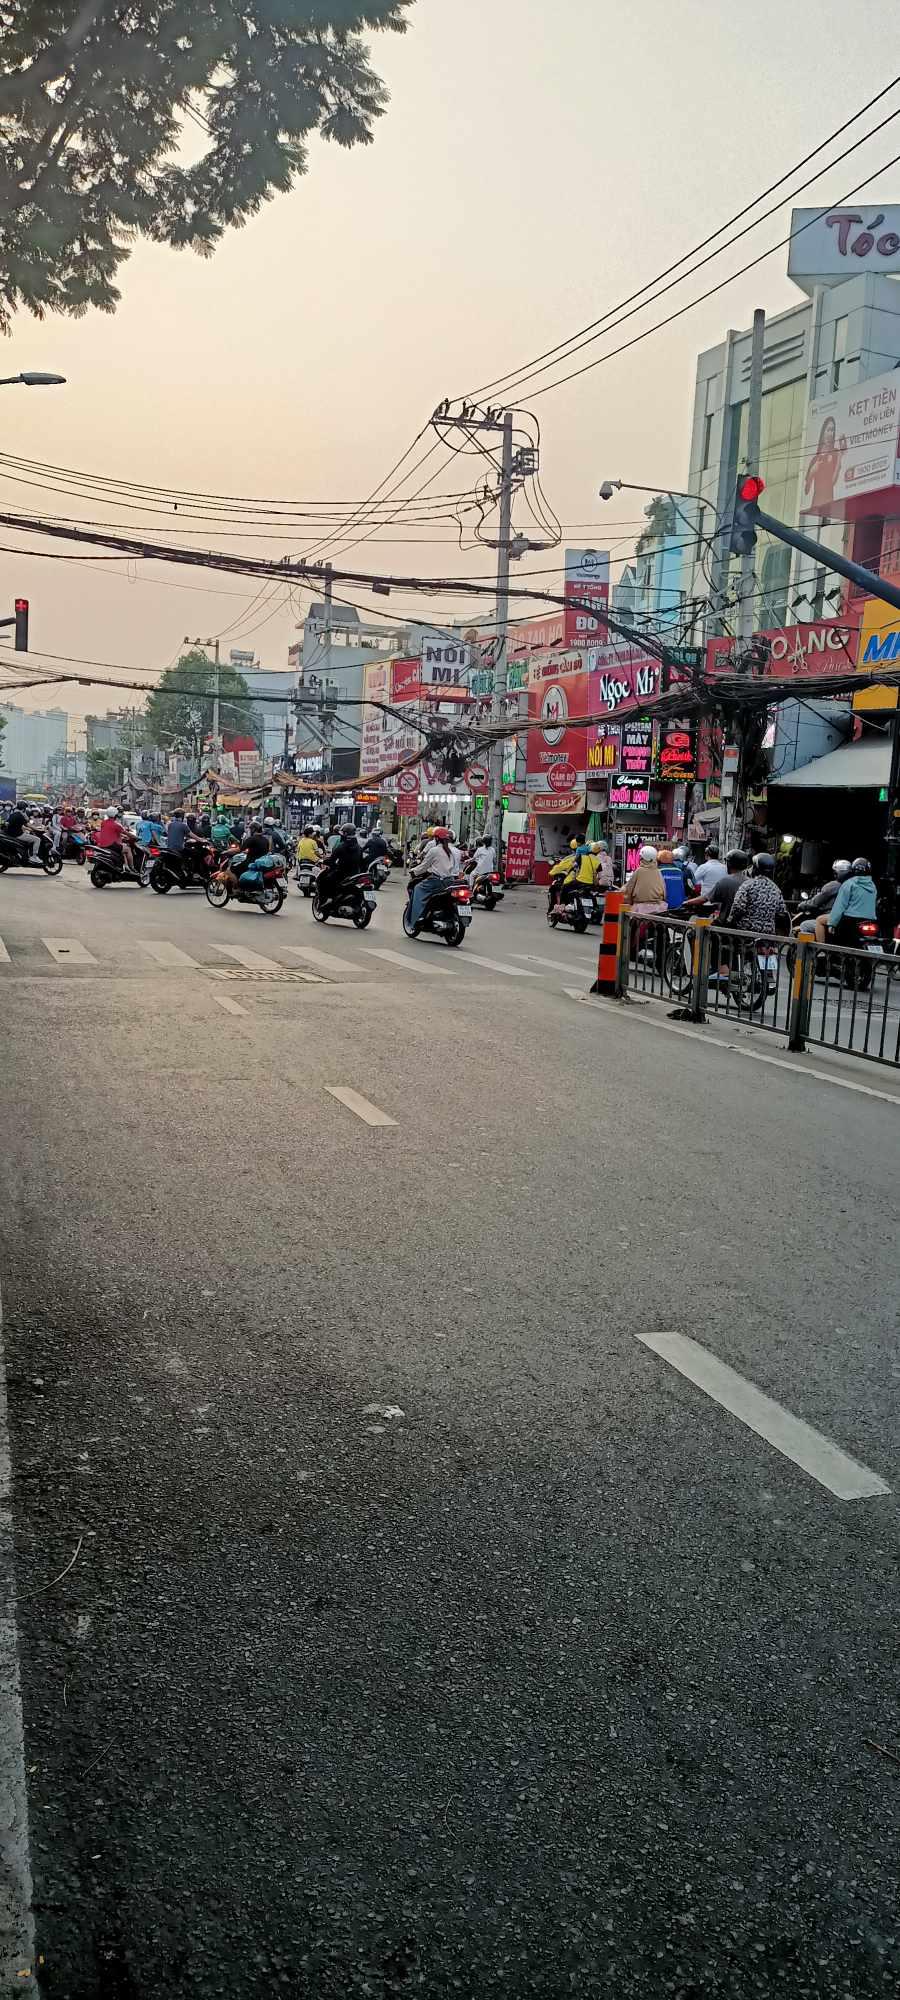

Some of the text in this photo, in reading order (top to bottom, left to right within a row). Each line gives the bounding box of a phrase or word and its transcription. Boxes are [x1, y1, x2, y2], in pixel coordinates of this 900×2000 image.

[826, 214, 900, 257] Tóc
[600, 673, 632, 711] Ngọc
[509, 858, 530, 866] NAM
